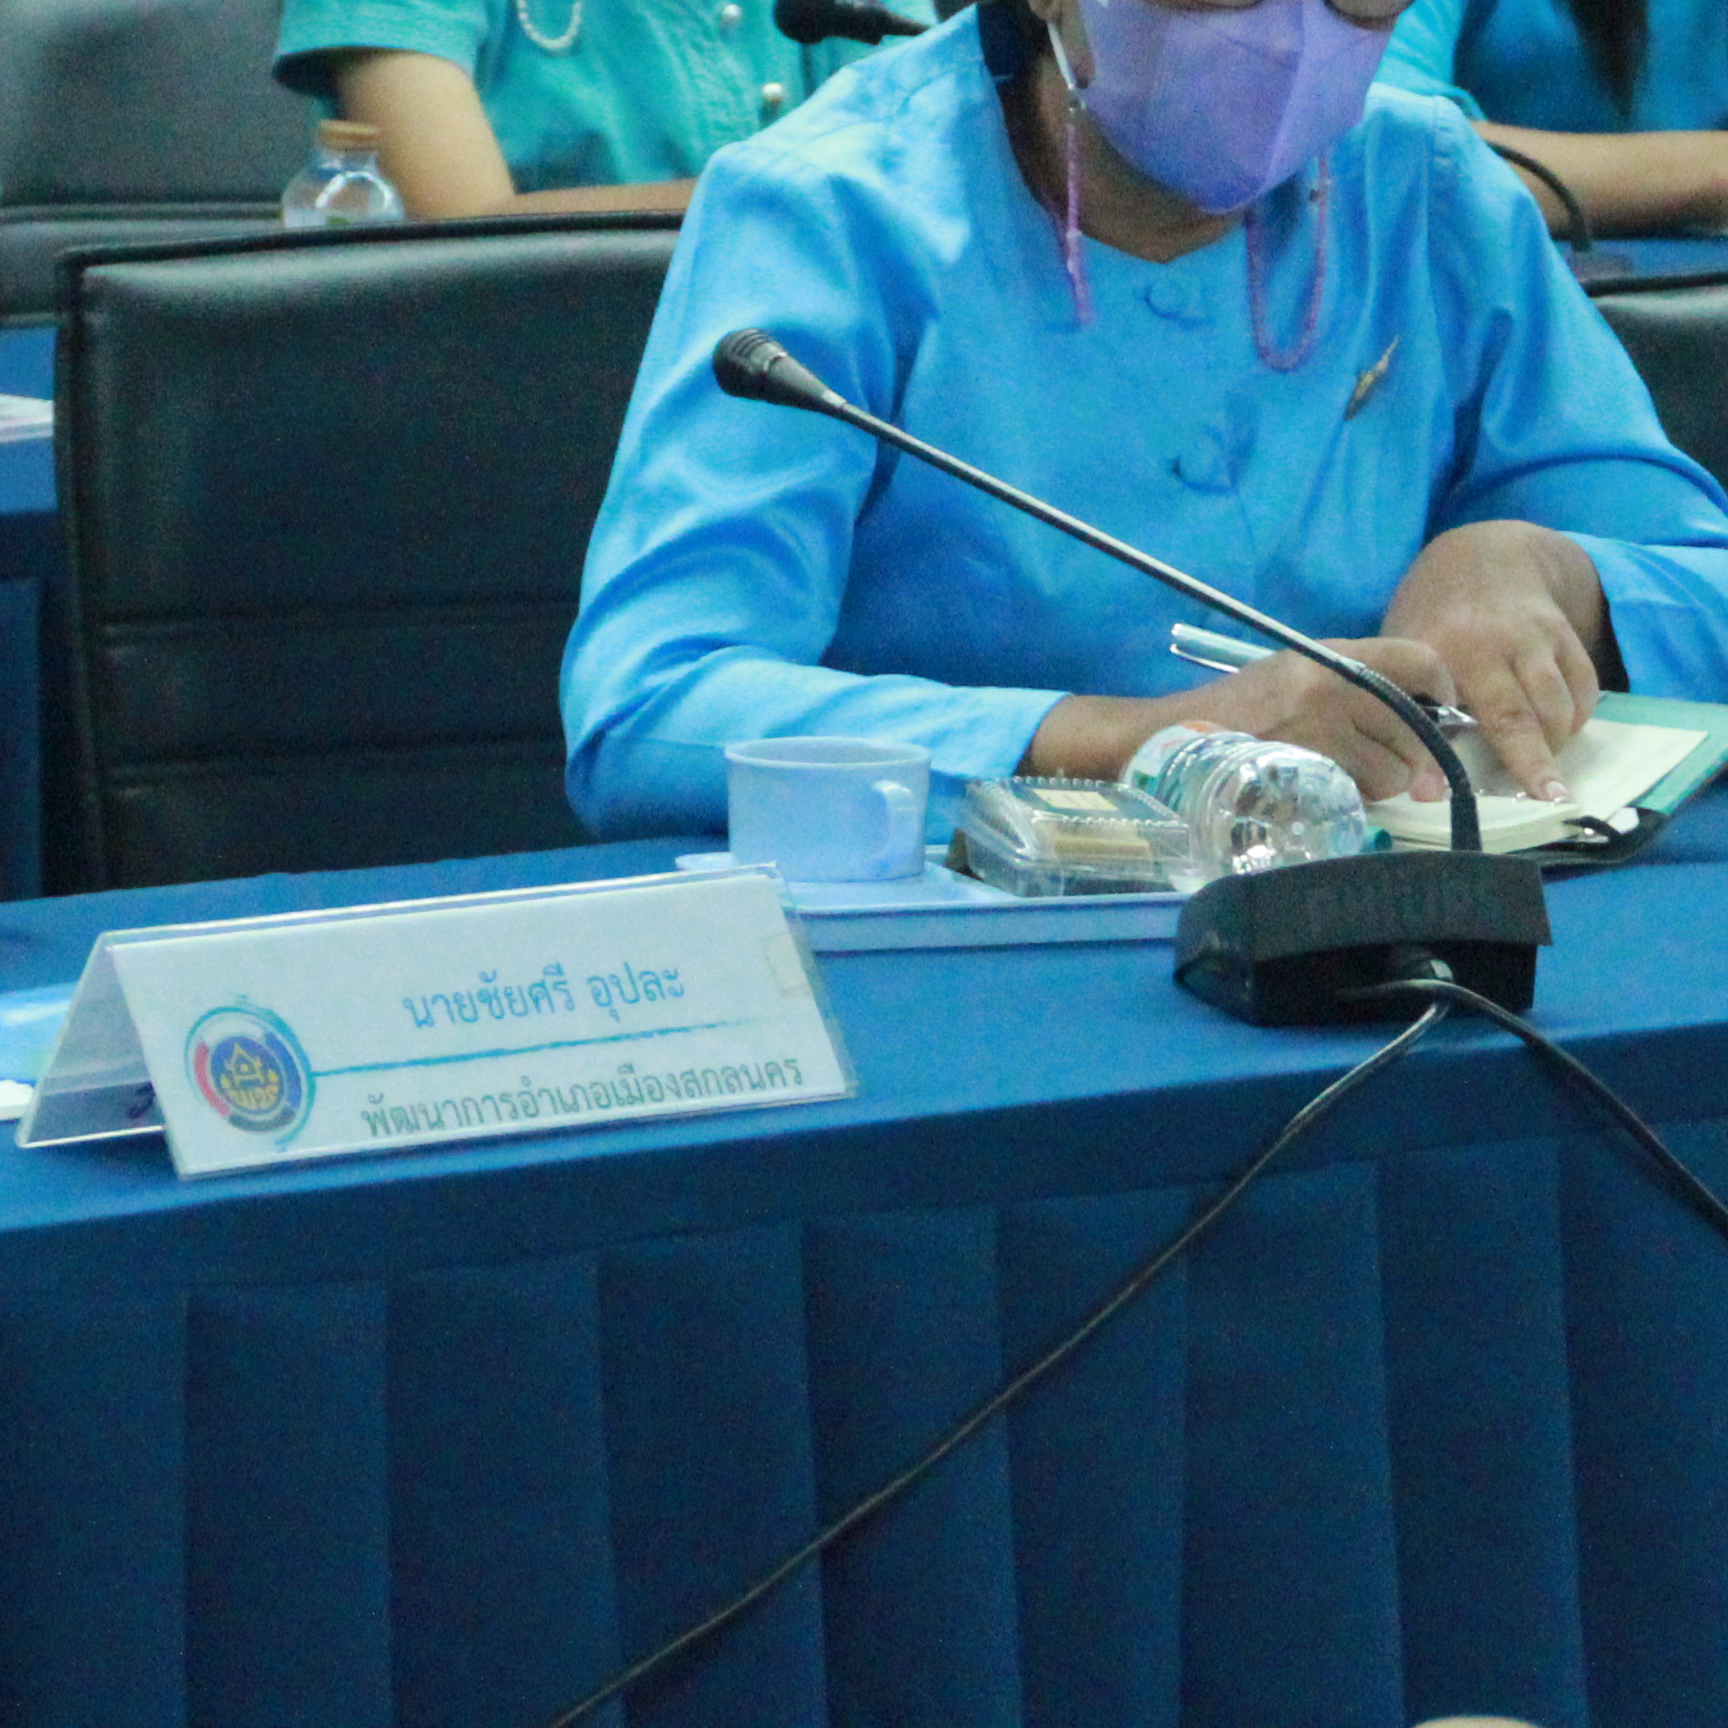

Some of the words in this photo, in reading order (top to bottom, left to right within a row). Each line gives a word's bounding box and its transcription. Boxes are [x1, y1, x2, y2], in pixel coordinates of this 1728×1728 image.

[586, 962, 685, 1023] อุปละ
[360, 1057, 804, 1137] พัฒนาการอำเภอเมืองสกลนคร
